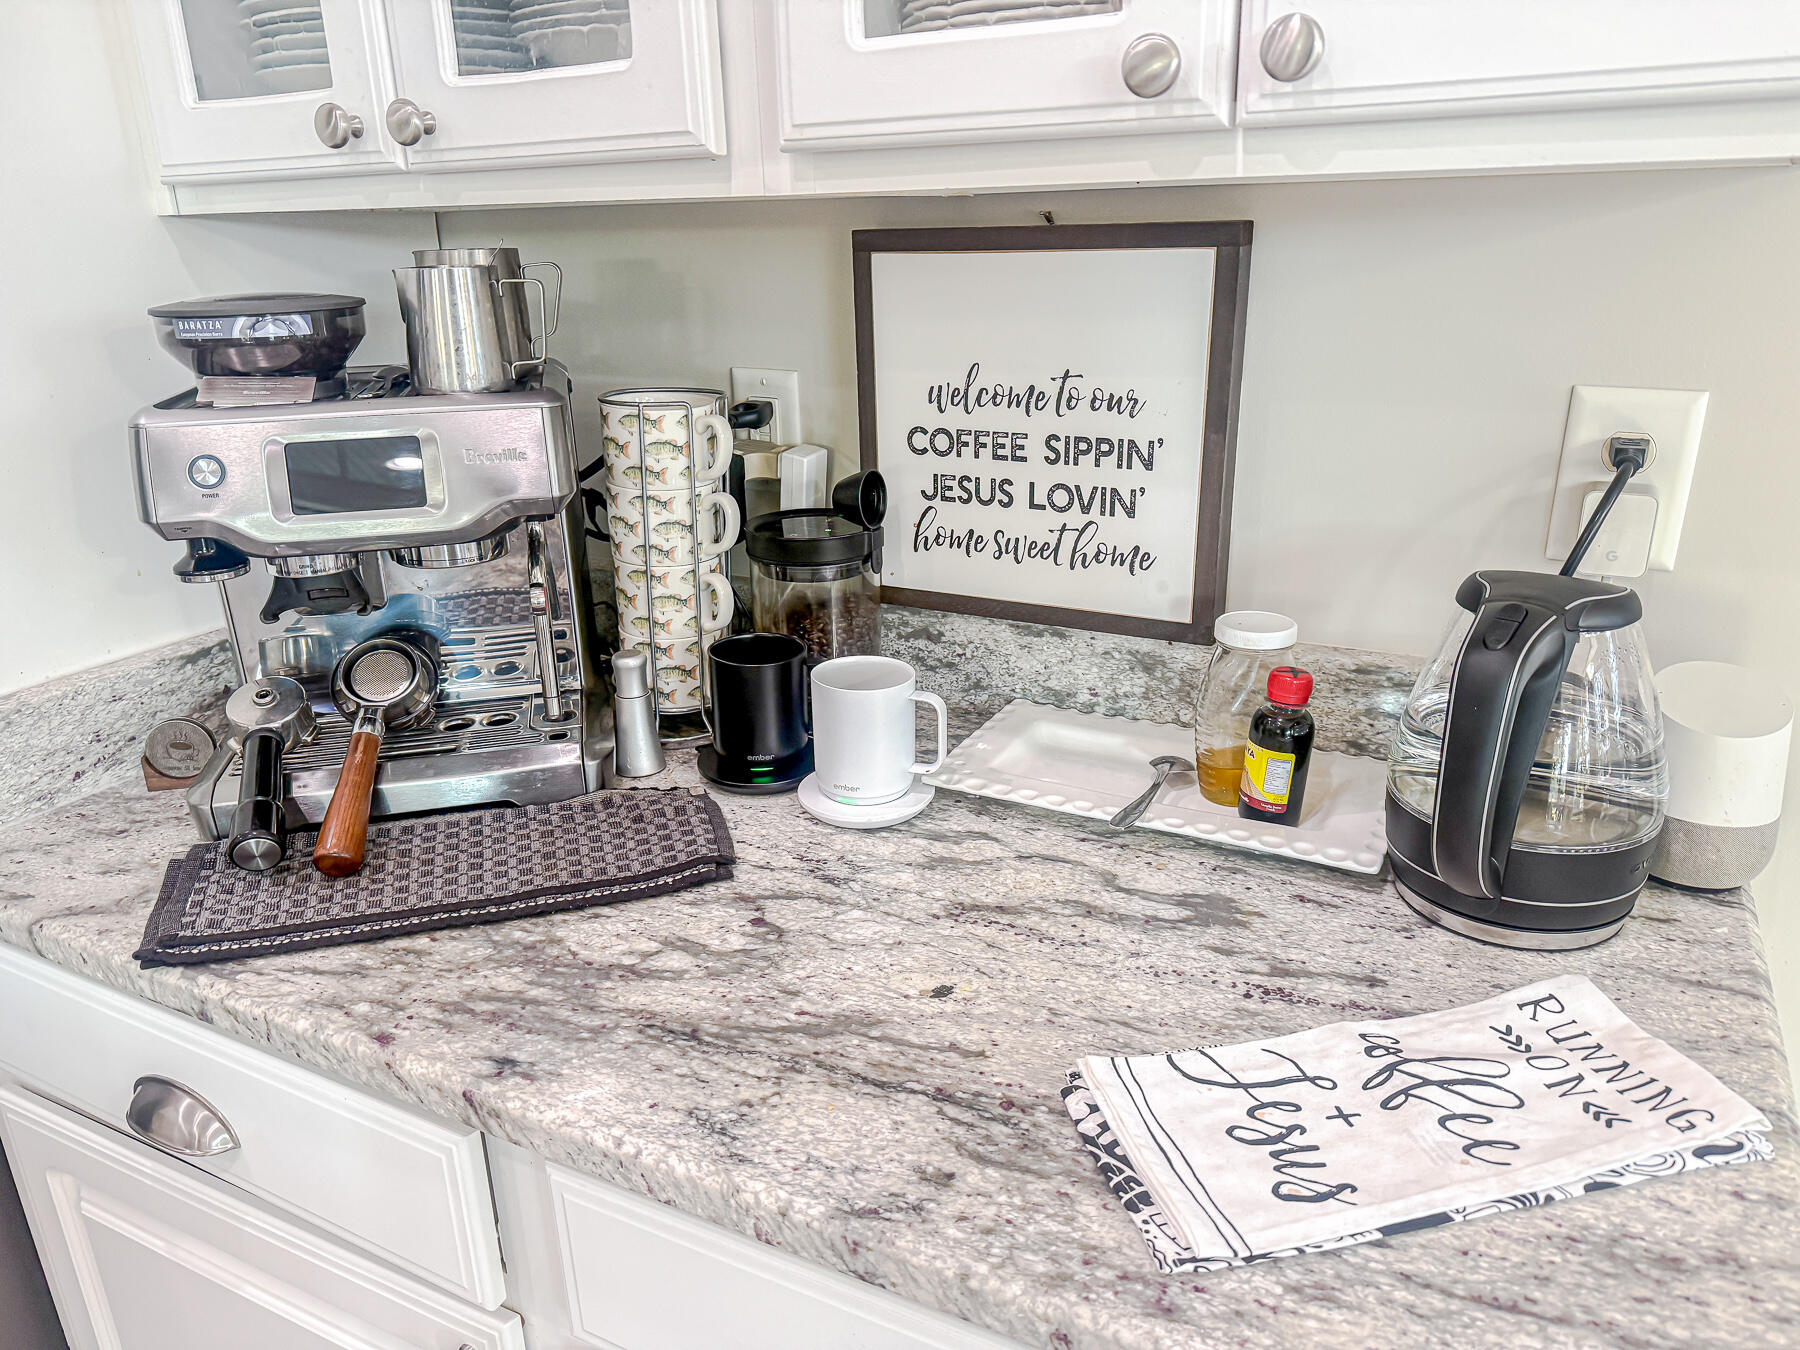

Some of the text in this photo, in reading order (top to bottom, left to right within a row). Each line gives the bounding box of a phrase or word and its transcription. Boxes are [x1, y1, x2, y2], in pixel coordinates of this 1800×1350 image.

[178, 320, 222, 330] BARATZA
[927, 362, 1147, 418] welcome to our
[907, 426, 1028, 462] COFFEE
[920, 473, 1014, 508] JESUS
[913, 505, 1157, 576] home sweet home
[833, 783, 861, 792] ember
[1517, 993, 1715, 1133] RUNNING
[1525, 1055, 1598, 1098] ON
[1359, 1033, 1525, 1165] coffee
[1166, 1048, 1358, 1206] Jesus
